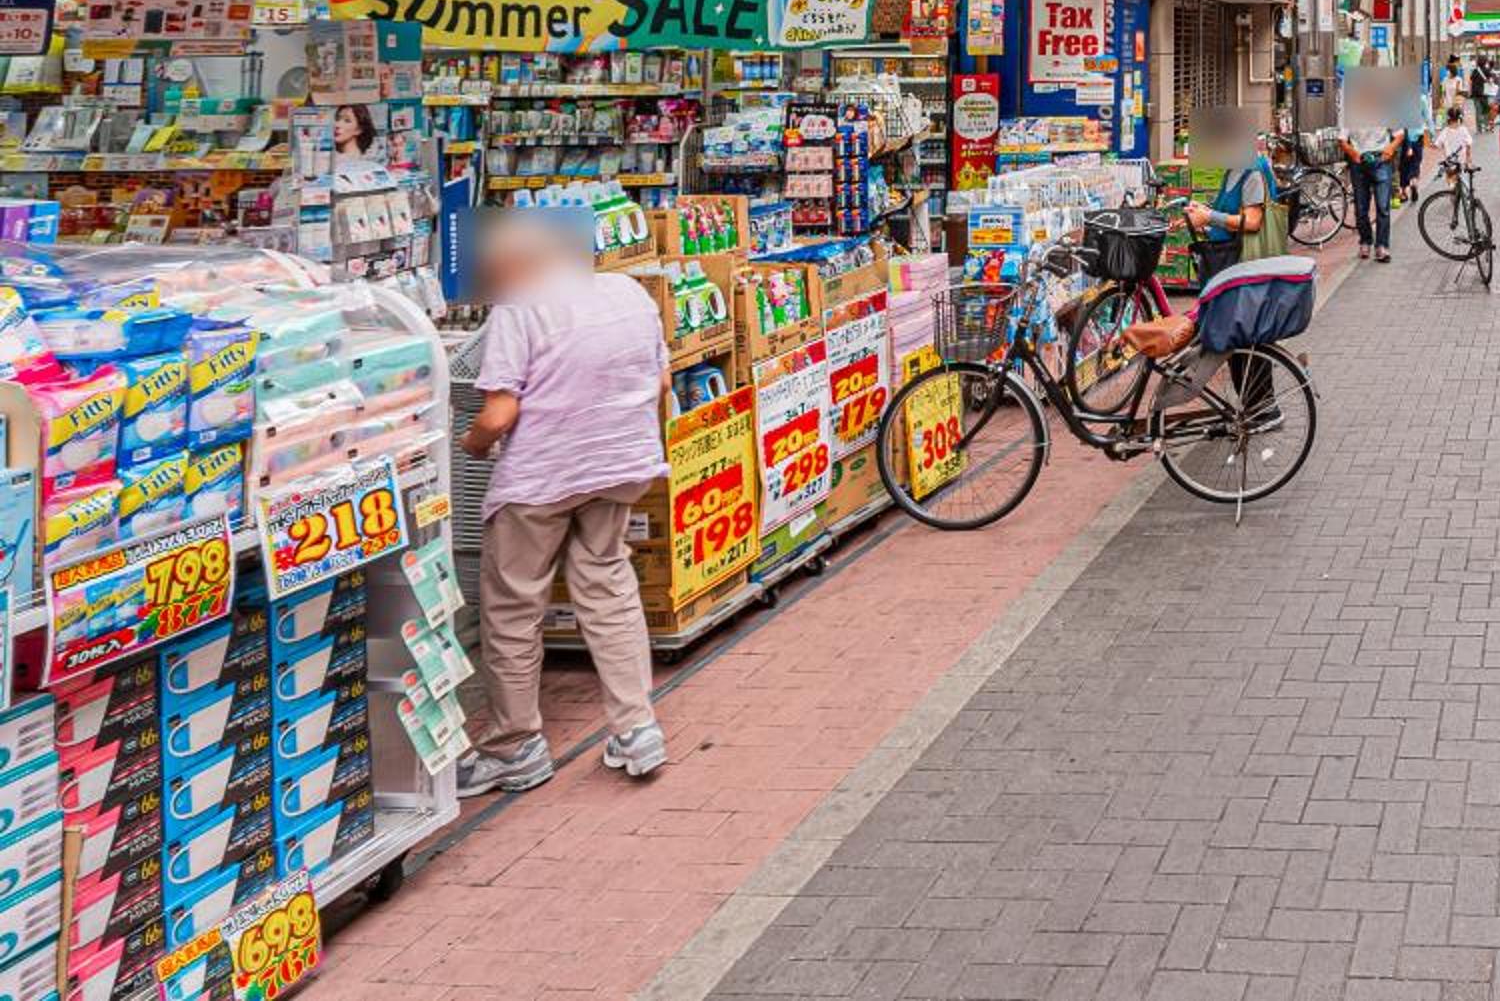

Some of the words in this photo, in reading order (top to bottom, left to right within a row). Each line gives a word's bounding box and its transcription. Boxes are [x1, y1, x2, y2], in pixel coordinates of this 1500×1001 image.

[1046, 2, 1093, 28] Tax
[1038, 31, 1098, 56] Free
[141, 365, 182, 397] Fitty
[209, 346, 246, 374] Fitty
[69, 395, 113, 427] Fitty
[840, 386, 887, 434] 179
[922, 415, 961, 470] 308
[139, 463, 181, 497] Fitty
[782, 443, 829, 497] 298
[288, 488, 398, 564] 218
[694, 502, 753, 566] 198
[145, 537, 230, 604] 798
[156, 585, 226, 640] 877
[239, 890, 316, 976] 698
[259, 936, 319, 1000] 767
